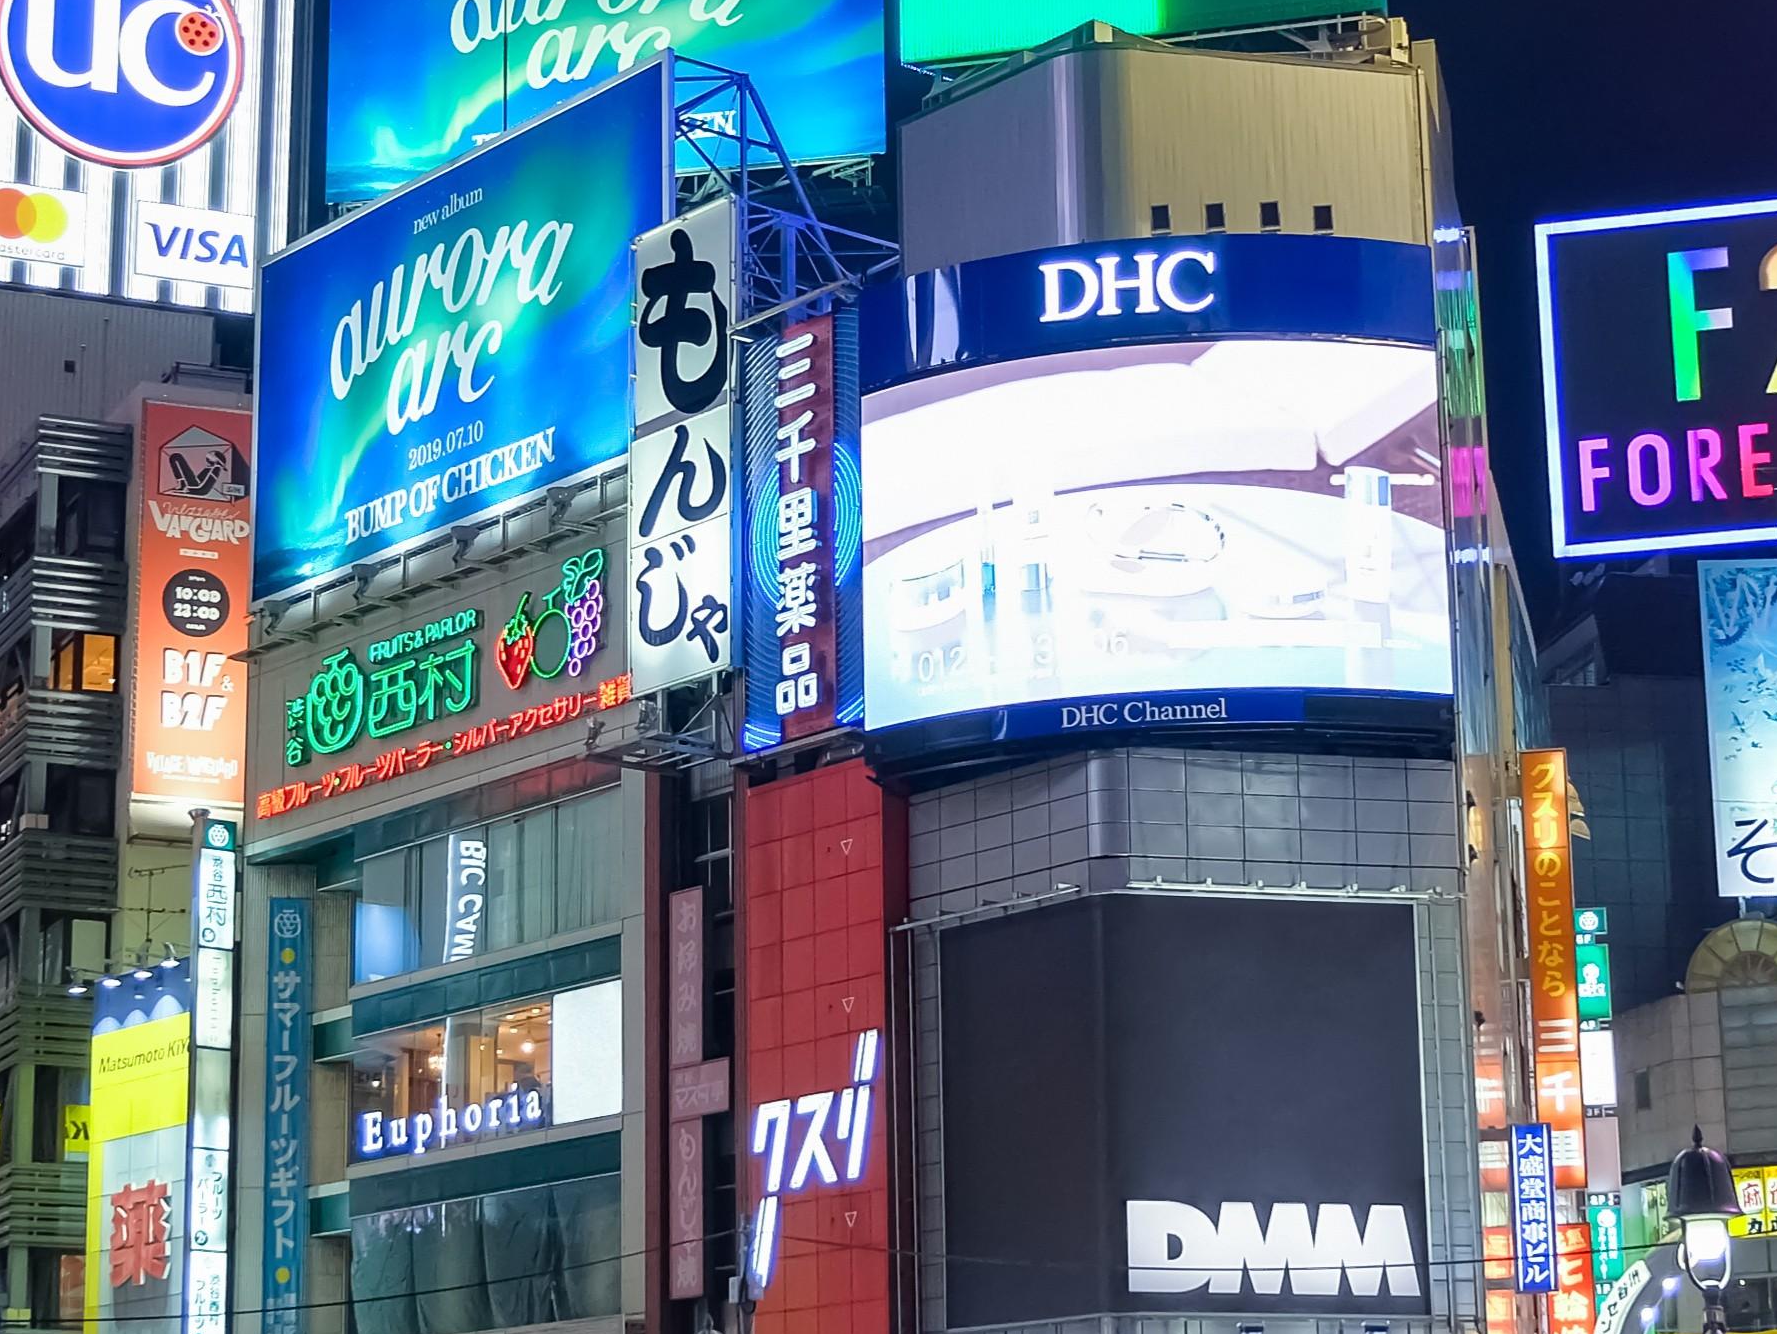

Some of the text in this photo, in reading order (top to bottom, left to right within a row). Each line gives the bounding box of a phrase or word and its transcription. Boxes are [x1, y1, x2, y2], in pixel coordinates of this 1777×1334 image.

[144, 220, 248, 269] VISA
[413, 186, 484, 235] new album
[330, 219, 574, 401] aurora
[1038, 249, 1217, 324] DHC
[385, 321, 502, 436] arc
[345, 427, 556, 546] BUMP OF CHICKEN
[408, 420, 484, 471] 2019.07.10
[636, 228, 729, 664] もんじゃ
[159, 690, 228, 731] B2F
[163, 647, 235, 692] B1F &
[368, 639, 476, 739] 西村
[1061, 697, 1228, 729] DHC Channel
[459, 840, 487, 886] BIC
[1529, 761, 1568, 999] クスリのことなら
[98, 1045, 165, 1075] Matsumoto
[269, 970, 302, 1258] サマーフルーツギフト
[359, 1086, 544, 1156] Euphoria
[107, 1178, 173, 1287] 薬
[1126, 1199, 1421, 1297] DMM
[1518, 1132, 1550, 1284] 大盛堂商事ビル
